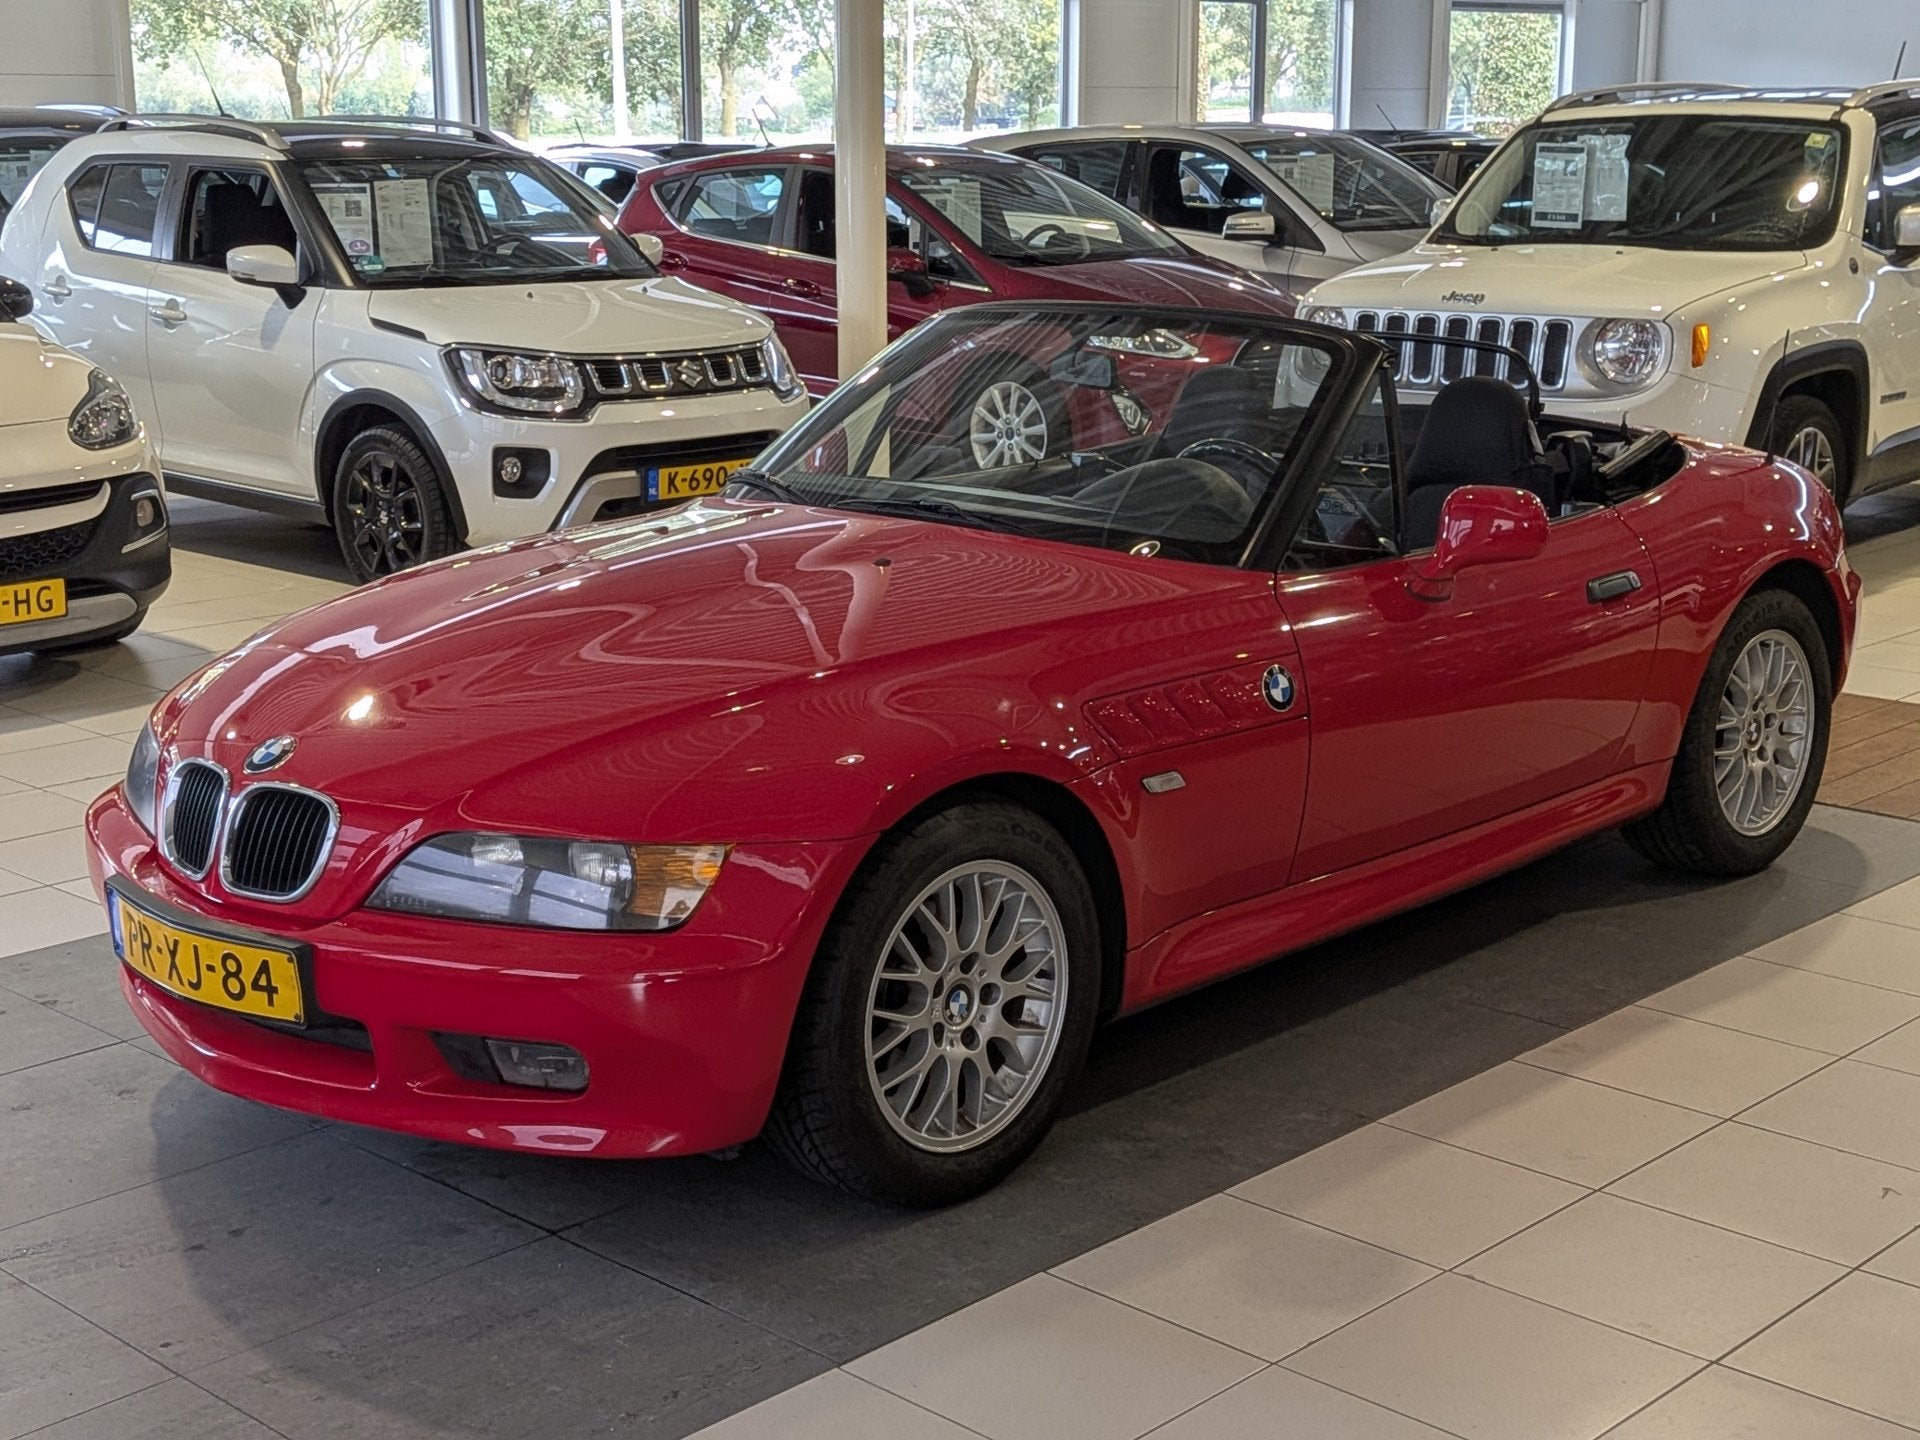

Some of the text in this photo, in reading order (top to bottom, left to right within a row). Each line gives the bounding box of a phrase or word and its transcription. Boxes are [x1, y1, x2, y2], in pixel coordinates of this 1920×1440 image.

[1441, 290, 1486, 306] Jeep
[667, 462, 751, 495] K-690
[648, 487, 658, 496] NL
[125, 910, 279, 1008] PR-XJ-84
